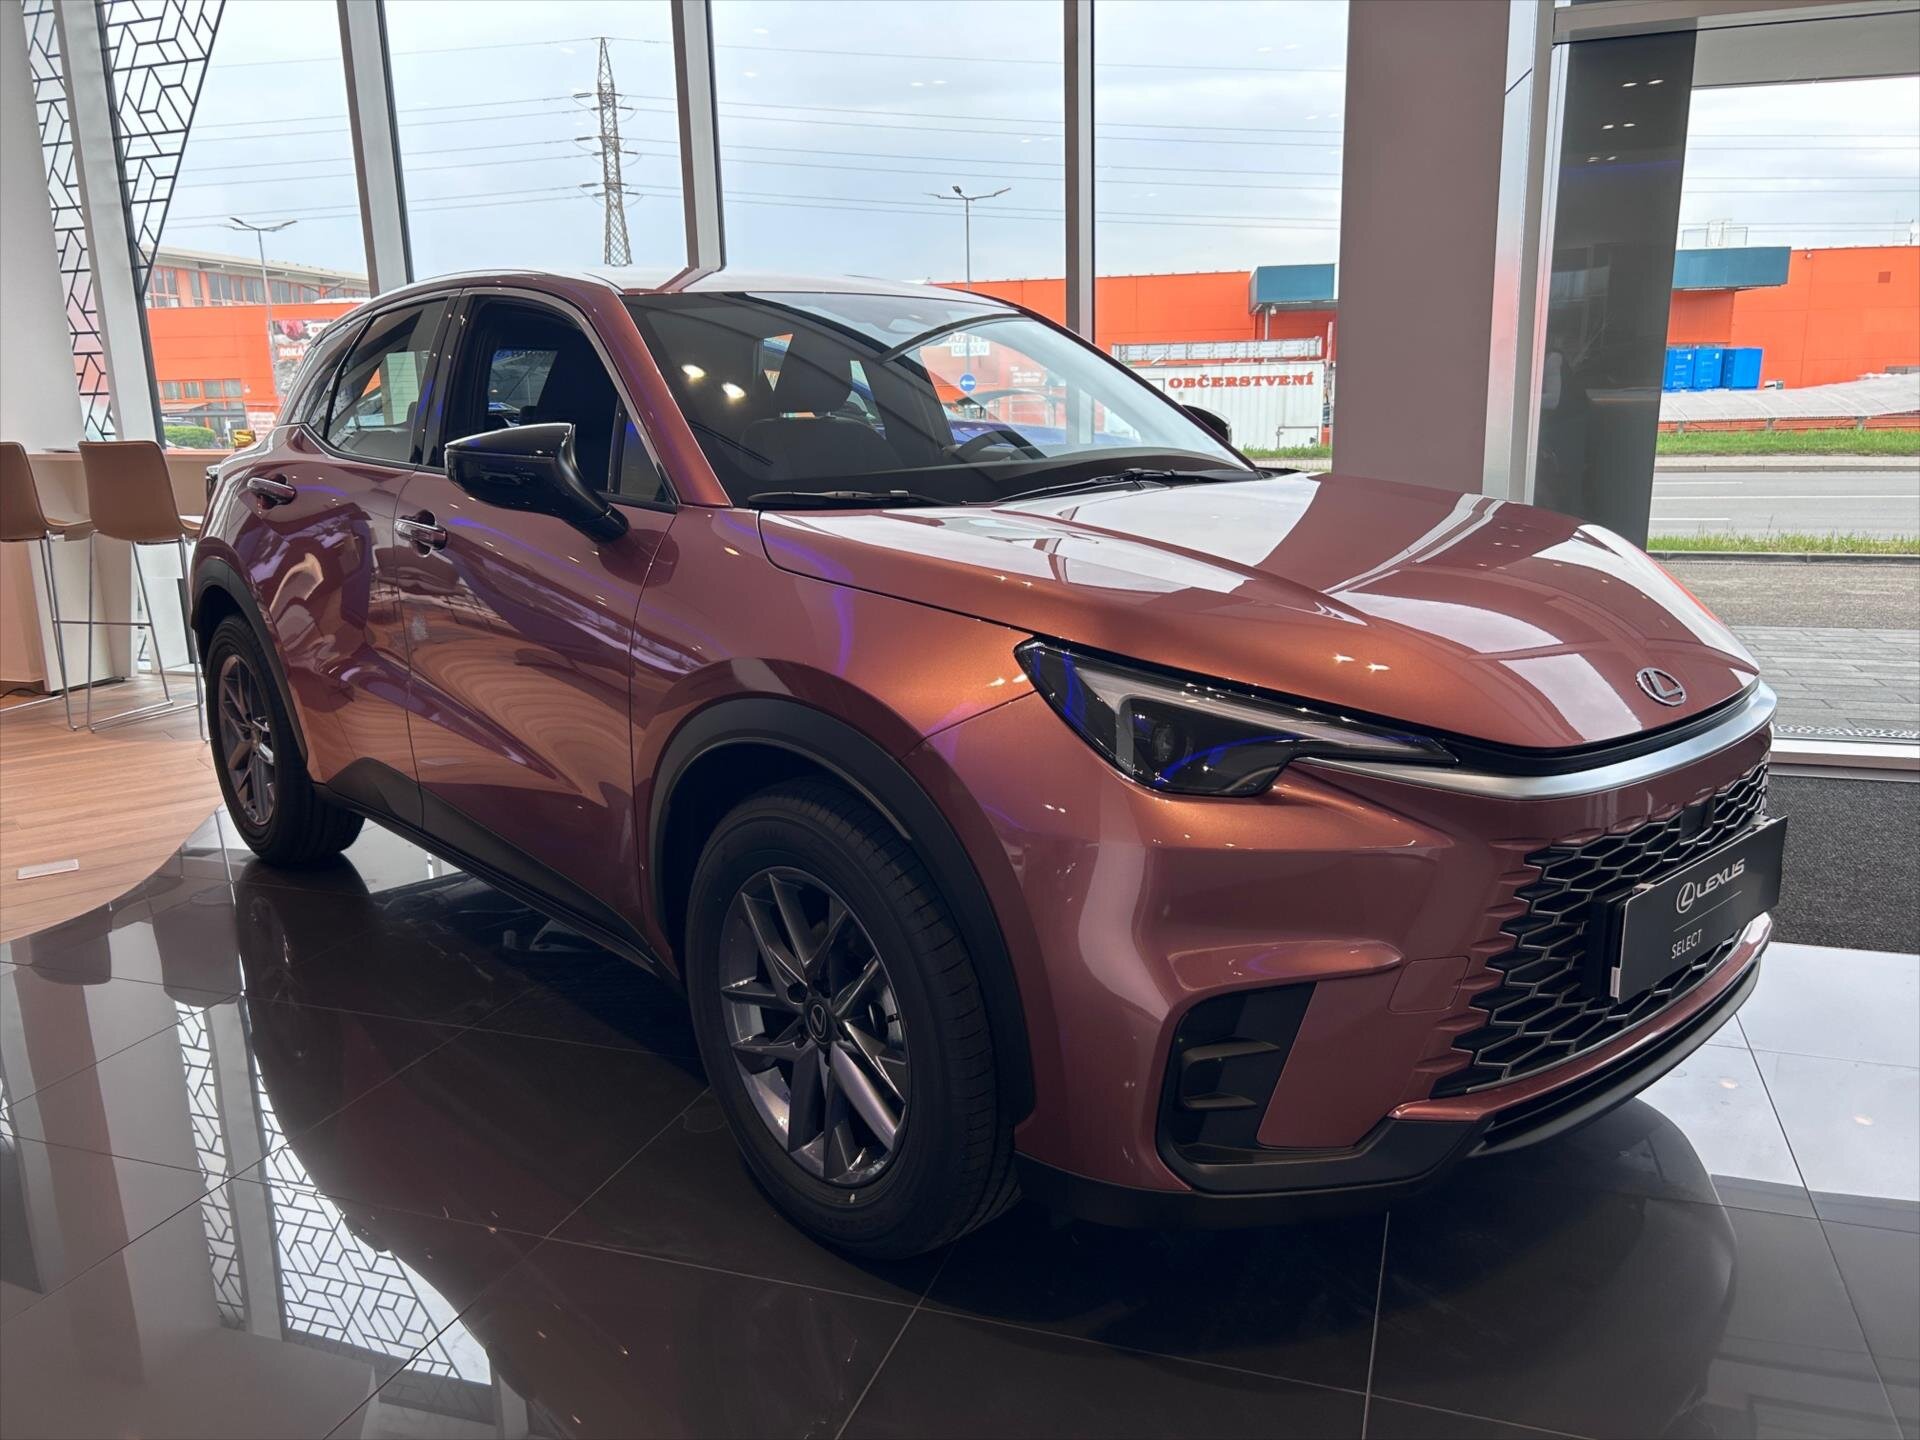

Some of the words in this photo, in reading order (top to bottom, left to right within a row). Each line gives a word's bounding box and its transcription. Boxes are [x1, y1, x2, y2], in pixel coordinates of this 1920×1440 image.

[1168, 371, 1314, 389] OBČERSTVENÍ
[1696, 858, 1745, 898] LEXUS
[1671, 928, 1703, 959] SELECT
